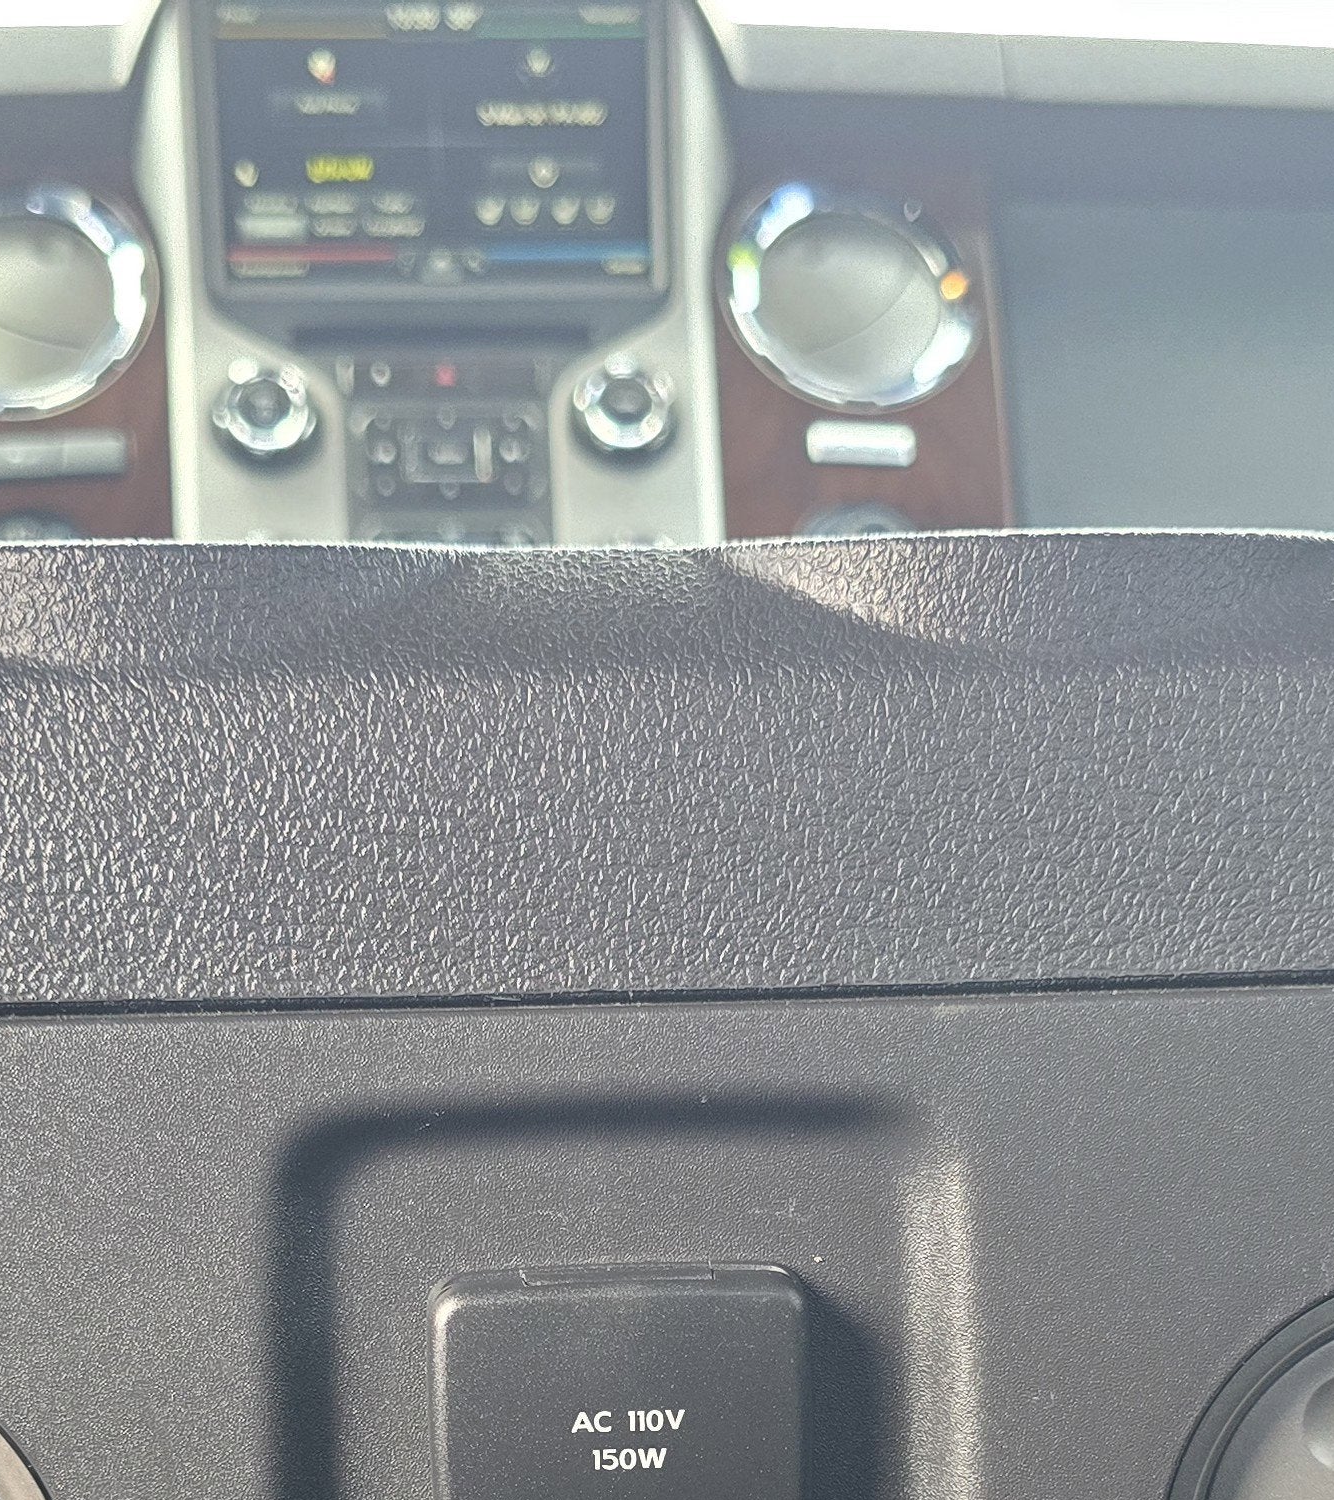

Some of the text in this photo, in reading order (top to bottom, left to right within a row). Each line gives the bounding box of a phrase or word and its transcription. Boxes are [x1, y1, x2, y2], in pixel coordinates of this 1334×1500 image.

[571, 1408, 686, 1434] AC 110V
[592, 1447, 668, 1471] 150W
